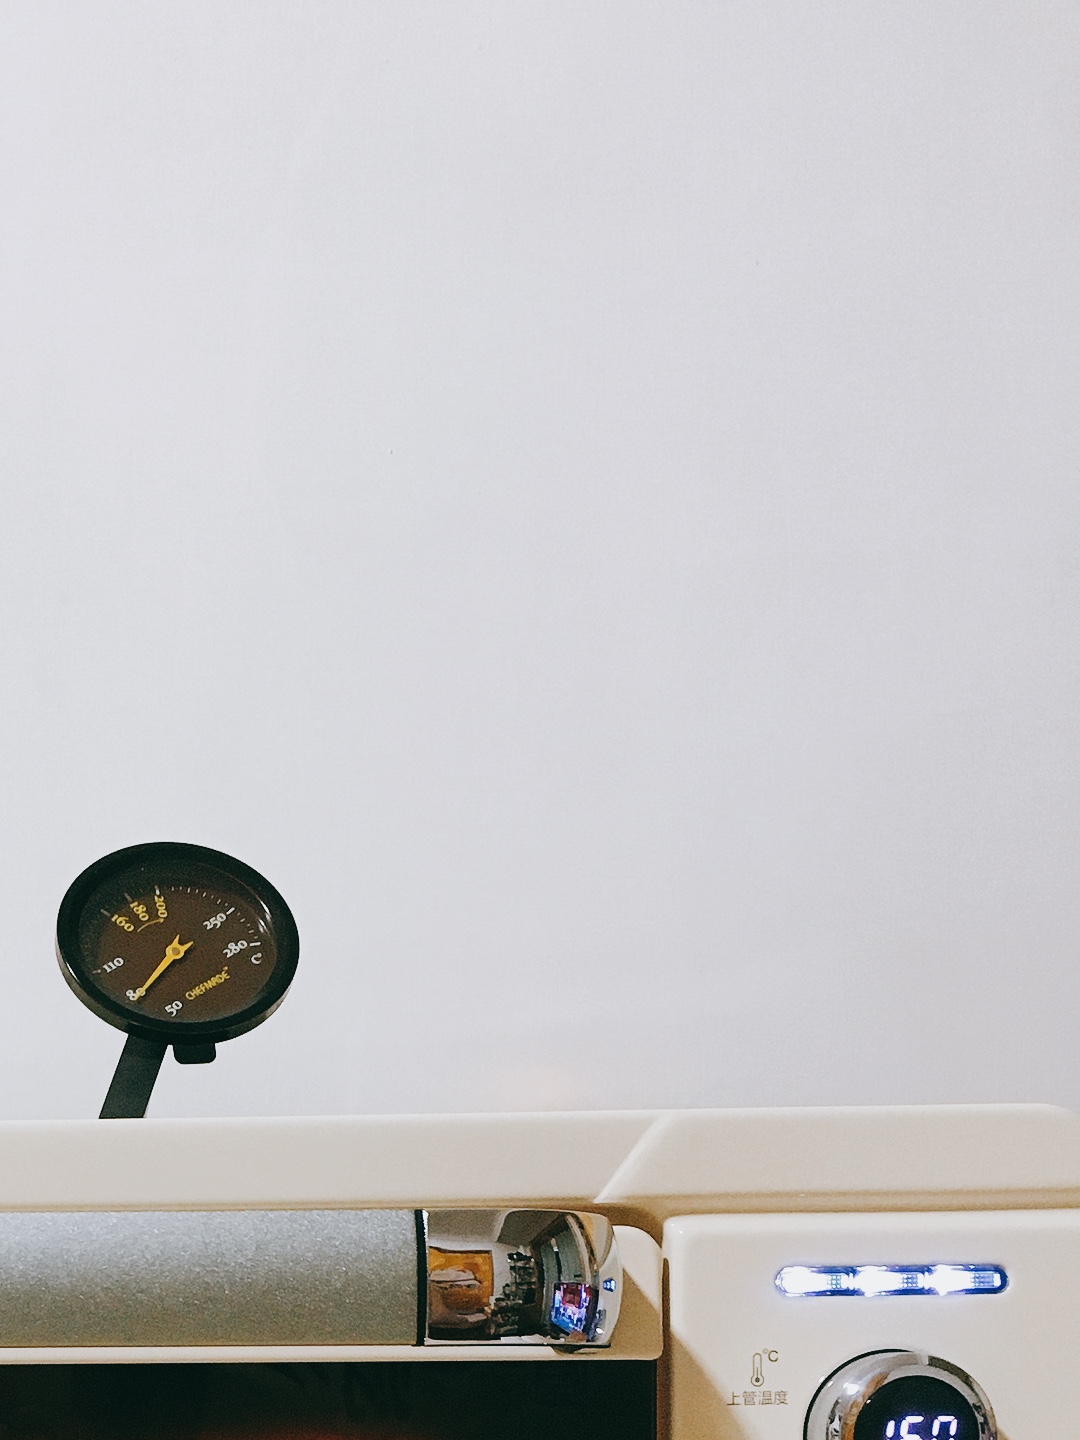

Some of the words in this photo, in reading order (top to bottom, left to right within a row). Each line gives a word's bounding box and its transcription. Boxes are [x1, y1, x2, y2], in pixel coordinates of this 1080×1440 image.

[130, 901, 149, 921] 180
[155, 895, 167, 918] 200
[111, 914, 134, 932] 160
[203, 913, 226, 930] 250
[222, 940, 248, 958] 280
[103, 957, 124, 973] 110
[165, 1001, 183, 1017] 50
[726, 1390, 789, 1407] 上管温度
